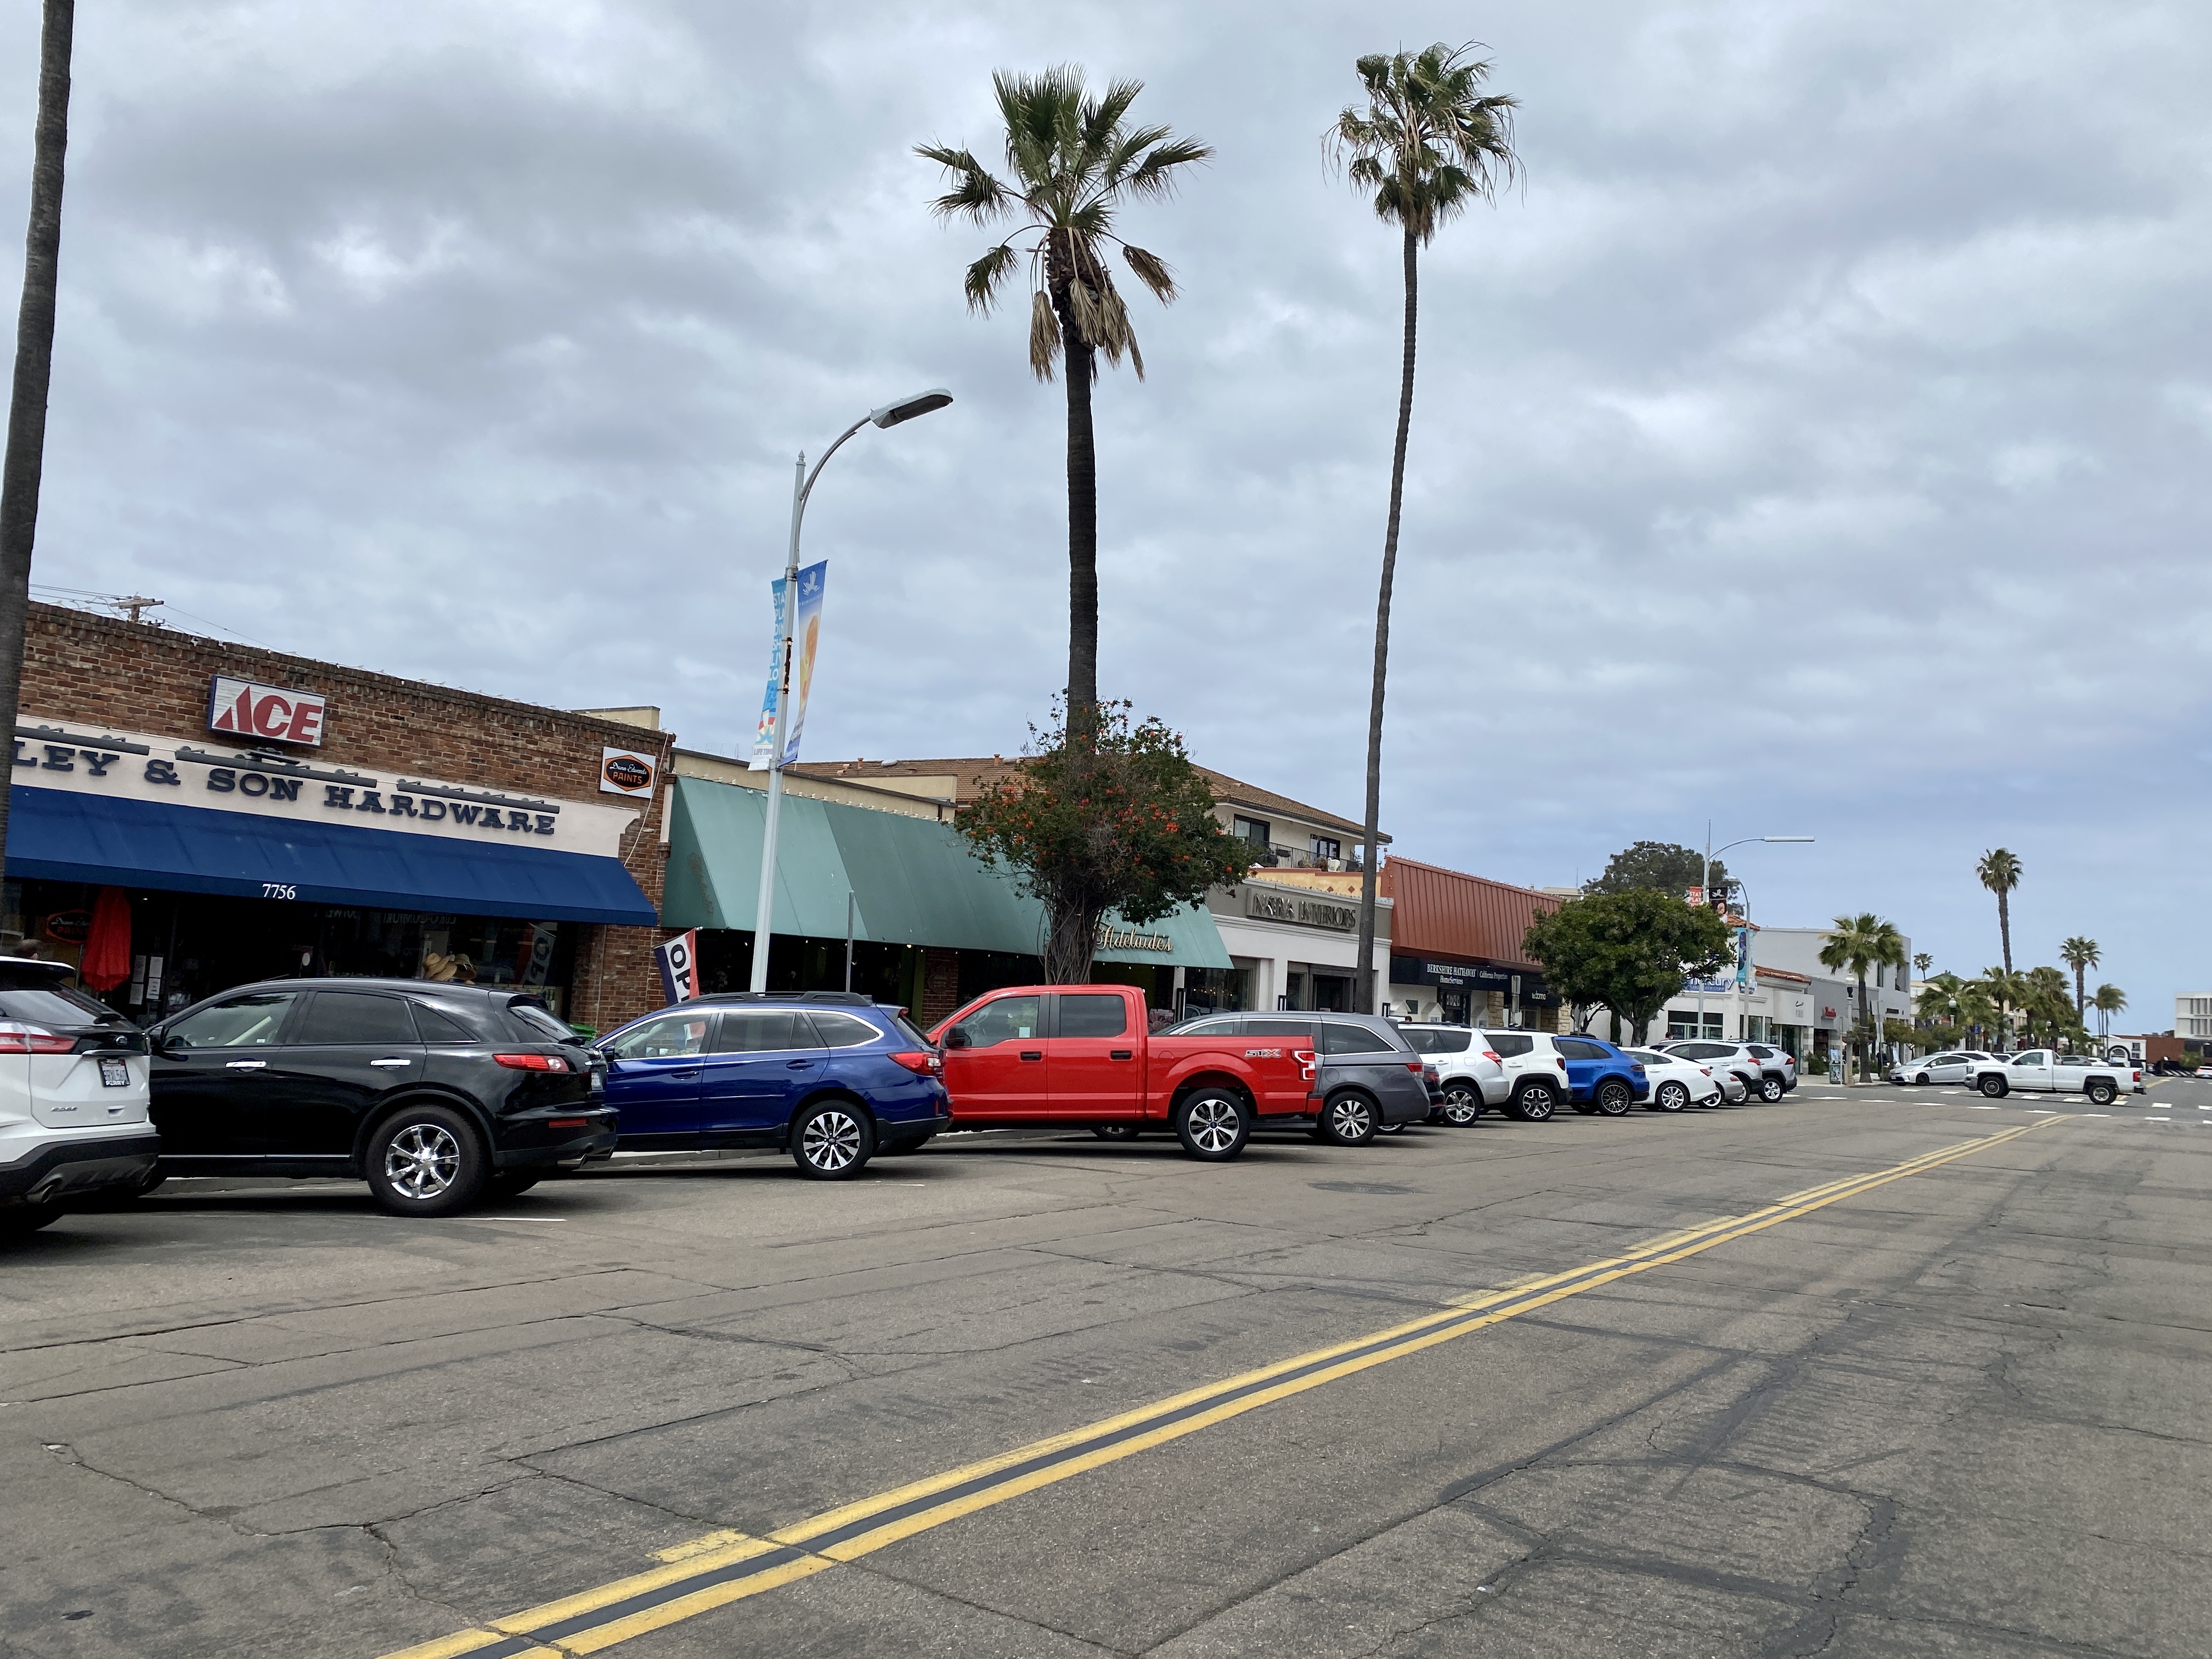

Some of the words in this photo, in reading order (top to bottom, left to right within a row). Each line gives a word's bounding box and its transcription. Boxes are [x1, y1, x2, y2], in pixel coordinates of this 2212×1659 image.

[775, 608, 785, 620] PLA
[772, 639, 781, 651] SH
[769, 668, 778, 681] LO
[213, 685, 323, 742] ACE
[613, 771, 642, 784] PAINTS
[144, 759, 181, 785] &
[207, 768, 303, 800] SON
[324, 785, 555, 834] HARDWARE
[262, 883, 296, 900] 7756
[670, 944, 690, 1002] OP
[1427, 964, 1453, 975] BERKSHIRE
[1453, 966, 1476, 977] HATHAWAY
[1690, 977, 1735, 990] mcury
[1244, 1048, 1282, 1058] STX
